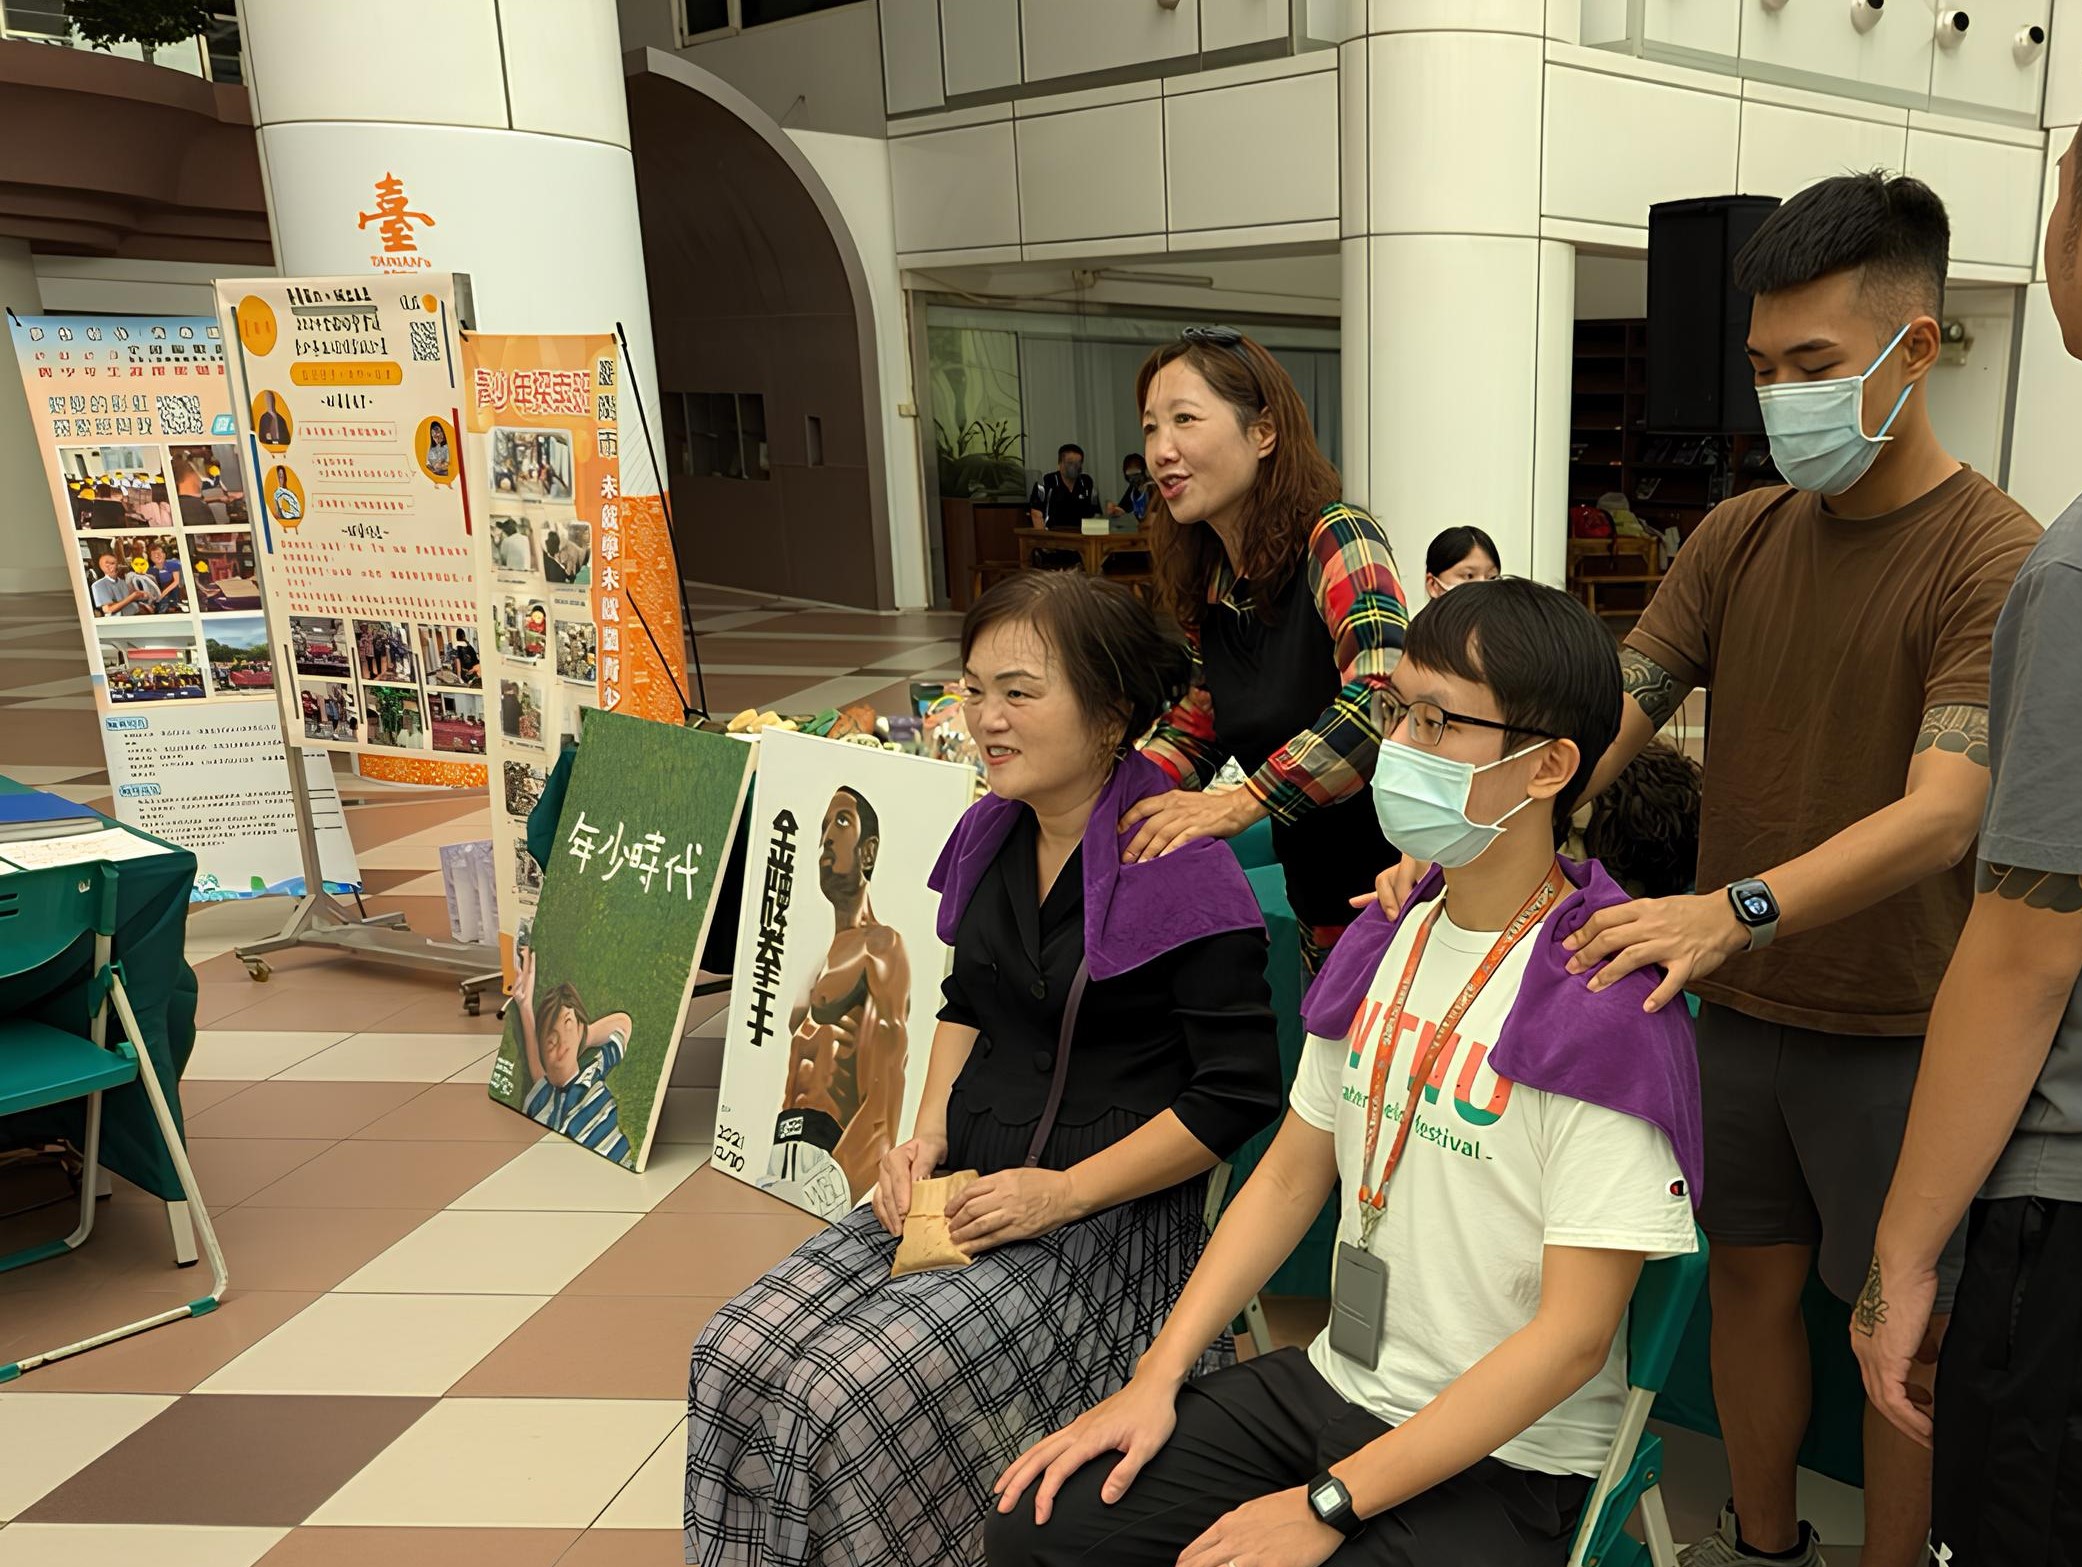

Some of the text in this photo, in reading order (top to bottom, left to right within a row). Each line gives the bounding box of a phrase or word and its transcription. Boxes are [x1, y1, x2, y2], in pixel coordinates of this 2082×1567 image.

[358, 171, 436, 252] 臺
[568, 811, 703, 901] 年少時代
[747, 808, 799, 1047] 金牌拳手
